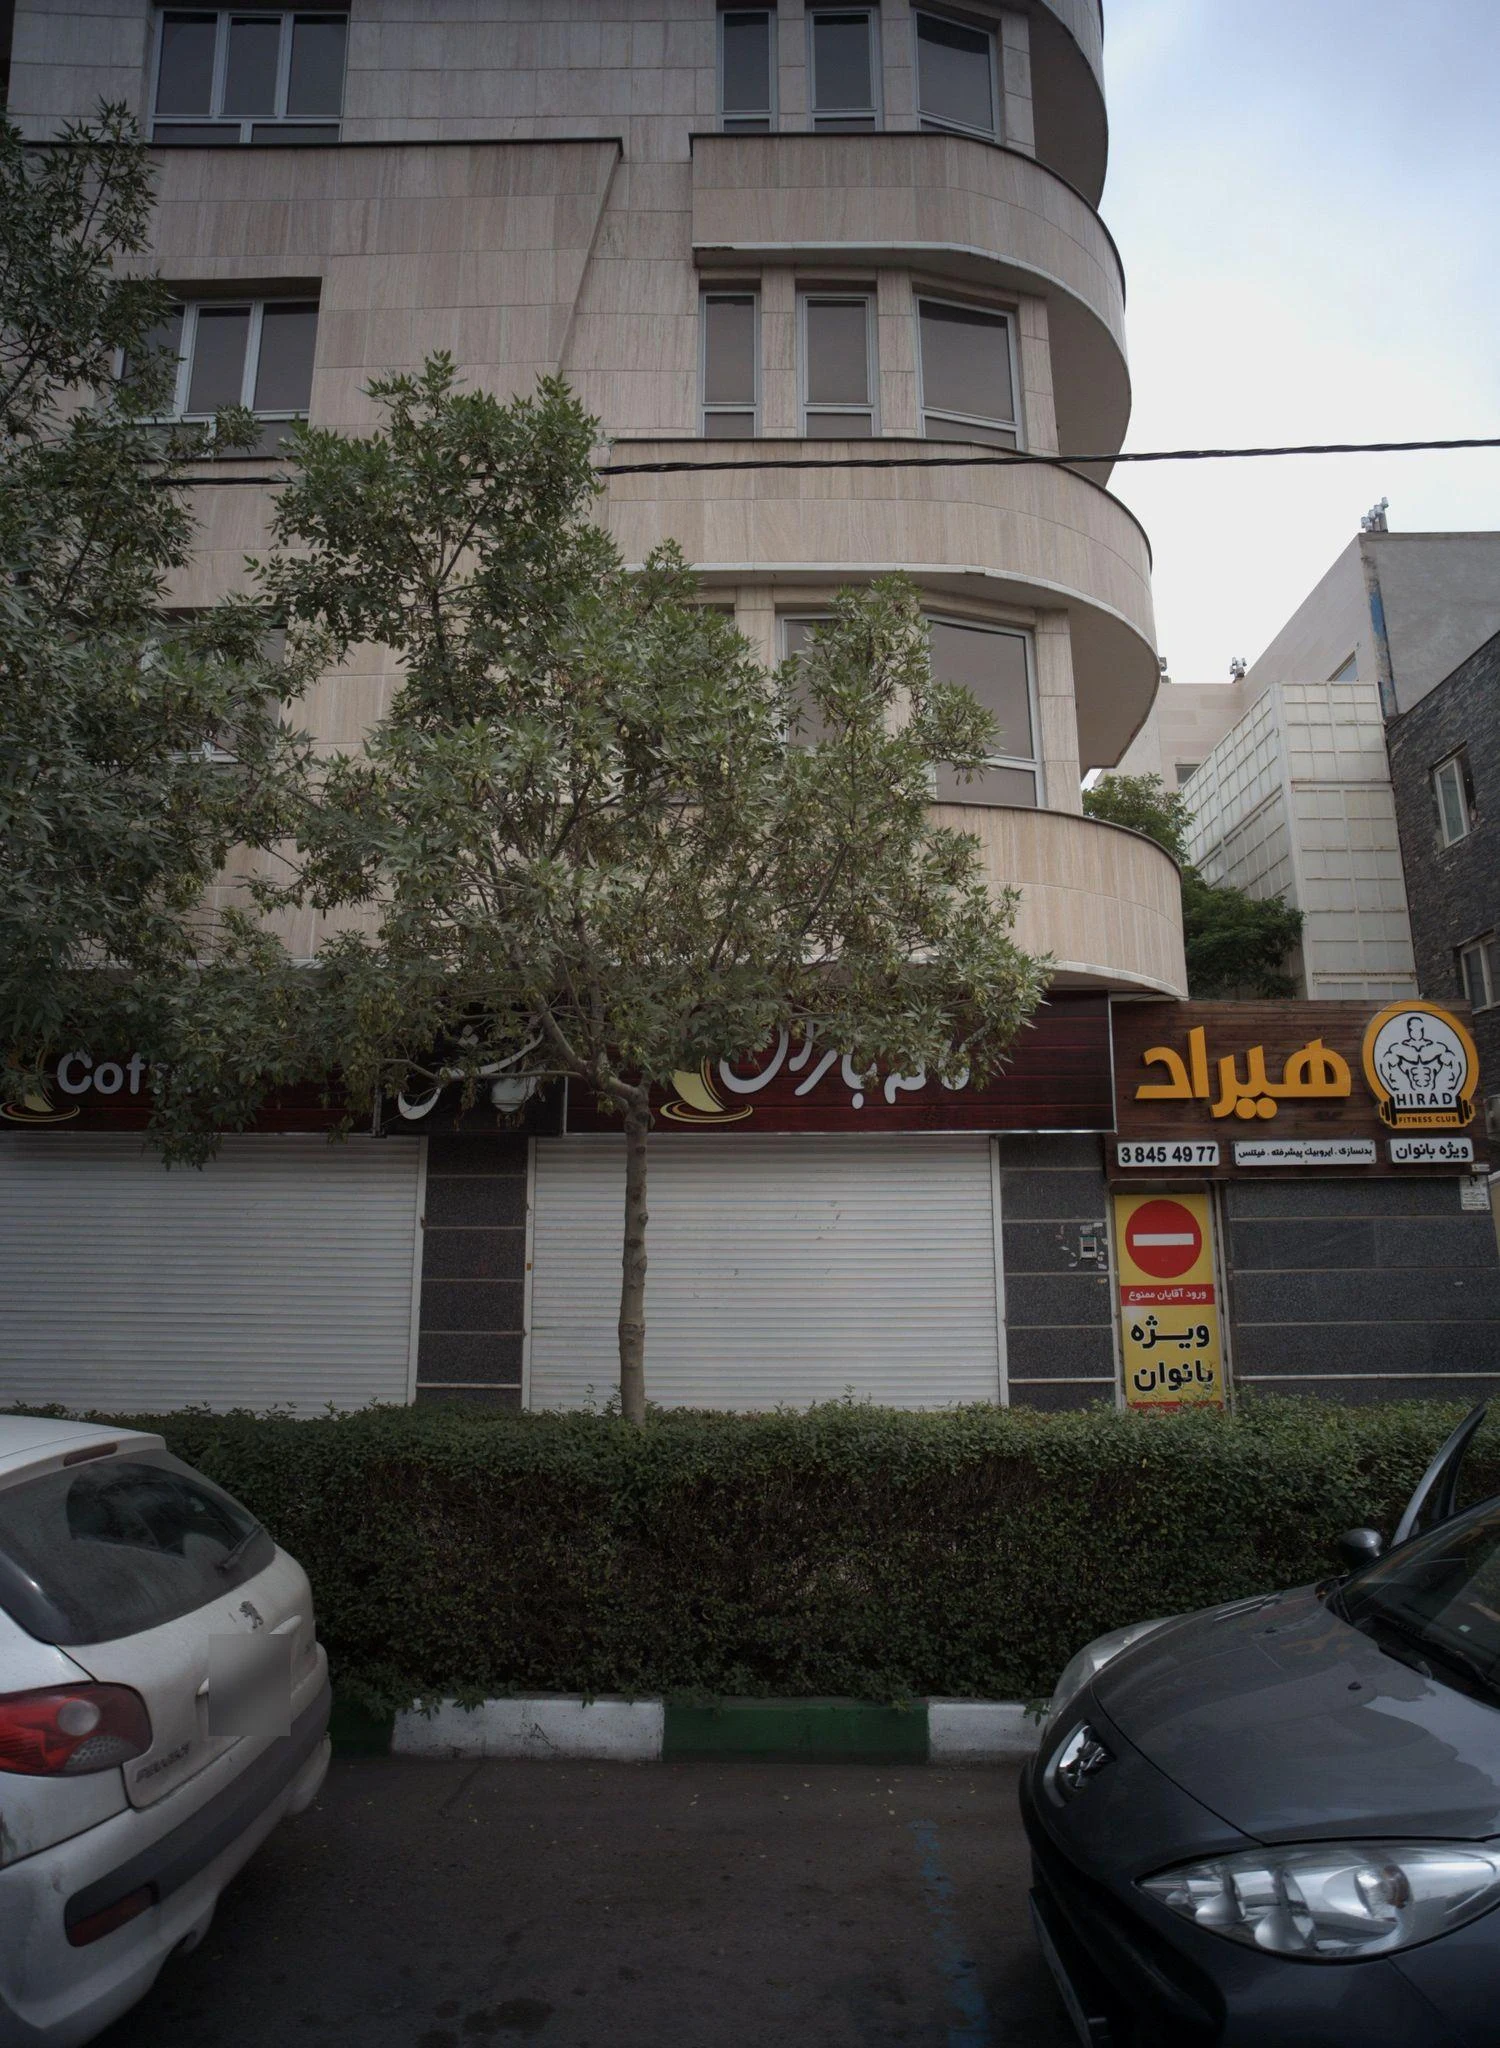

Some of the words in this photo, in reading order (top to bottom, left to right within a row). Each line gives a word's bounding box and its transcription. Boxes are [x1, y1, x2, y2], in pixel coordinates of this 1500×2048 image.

[1135, 1024, 1351, 1120] هیراد
[1396, 1092, 1453, 1106] HIRAD
[1398, 1116, 1433, 1124] FITNESS
[1435, 1115, 1457, 1123] CLUB
[1238, 1149, 1266, 1158] فیتنس
[1271, 1148, 1303, 1159] پیشرفته
[1395, 1143, 1436, 1159] بانوان
[1439, 1141, 1469, 1159] ویژه
[1128, 1290, 1156, 1302] ممنوع
[1157, 1287, 1184, 1301] آقایان
[1186, 1290, 1207, 1300] ورود
[1130, 1315, 1210, 1349] ویژه
[1133, 1359, 1213, 1393] بانوان
